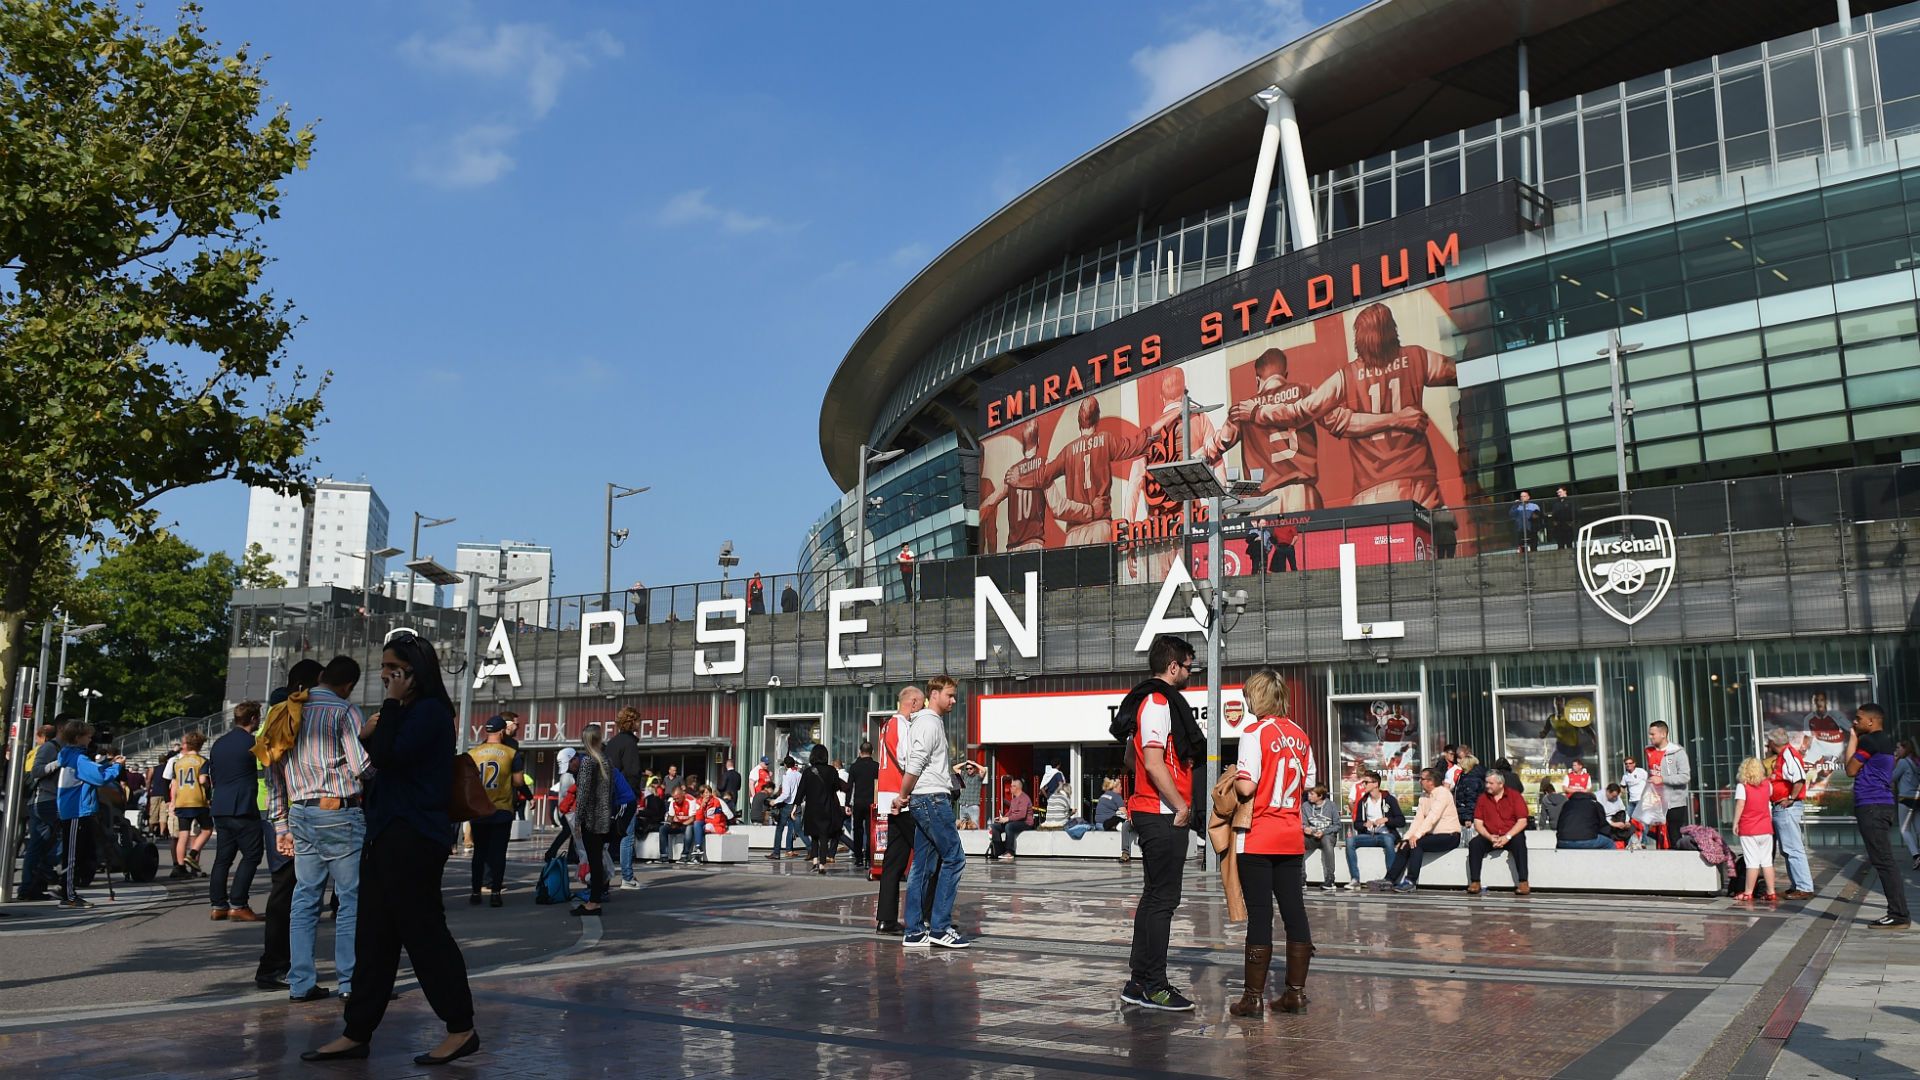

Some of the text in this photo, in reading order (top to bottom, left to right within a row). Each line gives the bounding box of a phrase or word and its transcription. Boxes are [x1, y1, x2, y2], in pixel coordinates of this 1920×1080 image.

[987, 232, 1460, 429] EMIRATES STADIUM
[1368, 377, 1408, 441] 11
[1072, 434, 1105, 455] WILSON
[1083, 453, 1092, 490] 1
[1016, 488, 1033, 521] 10
[1111, 506, 1213, 551] Emirate
[1589, 534, 1662, 556] Arsenal
[472, 542, 1405, 689] ARSENAL
[524, 719, 669, 741] BOX FCE
[1569, 712, 1591, 722] NOW
[1270, 736, 1307, 756] GIROUD
[178, 766, 197, 790] 14
[479, 760, 500, 789] 12
[1816, 763, 1845, 771] GUNN
[1269, 756, 1300, 809] 12
